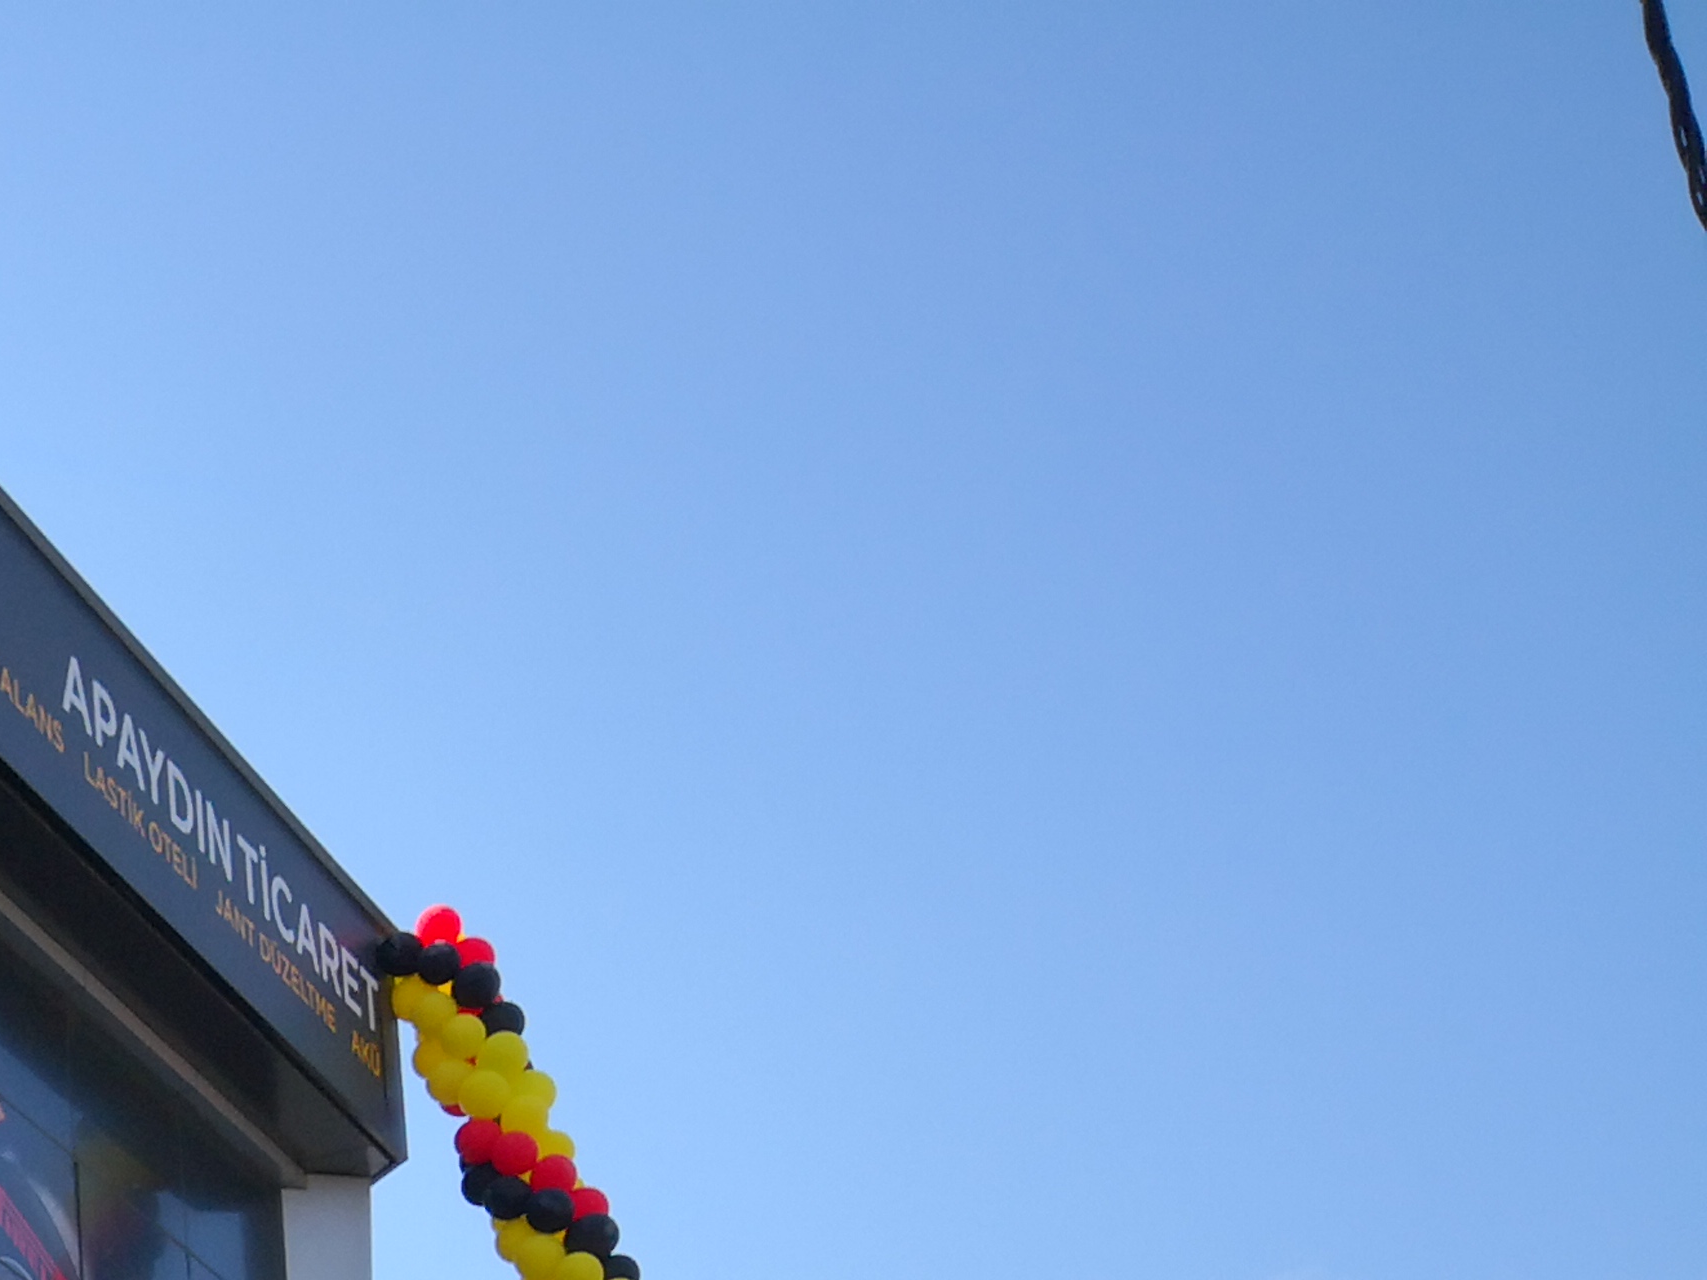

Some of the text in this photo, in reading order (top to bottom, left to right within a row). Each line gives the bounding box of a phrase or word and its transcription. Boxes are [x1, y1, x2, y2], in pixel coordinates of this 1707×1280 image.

[62, 655, 379, 1032] APAYDIN TİCARET
[84, 751, 147, 838] LASTİK
[148, 830, 198, 890] OTELİ
[216, 890, 256, 947] JANT
[259, 931, 337, 1033] DÜZELTME
[351, 1030, 382, 1078] AKÜ
